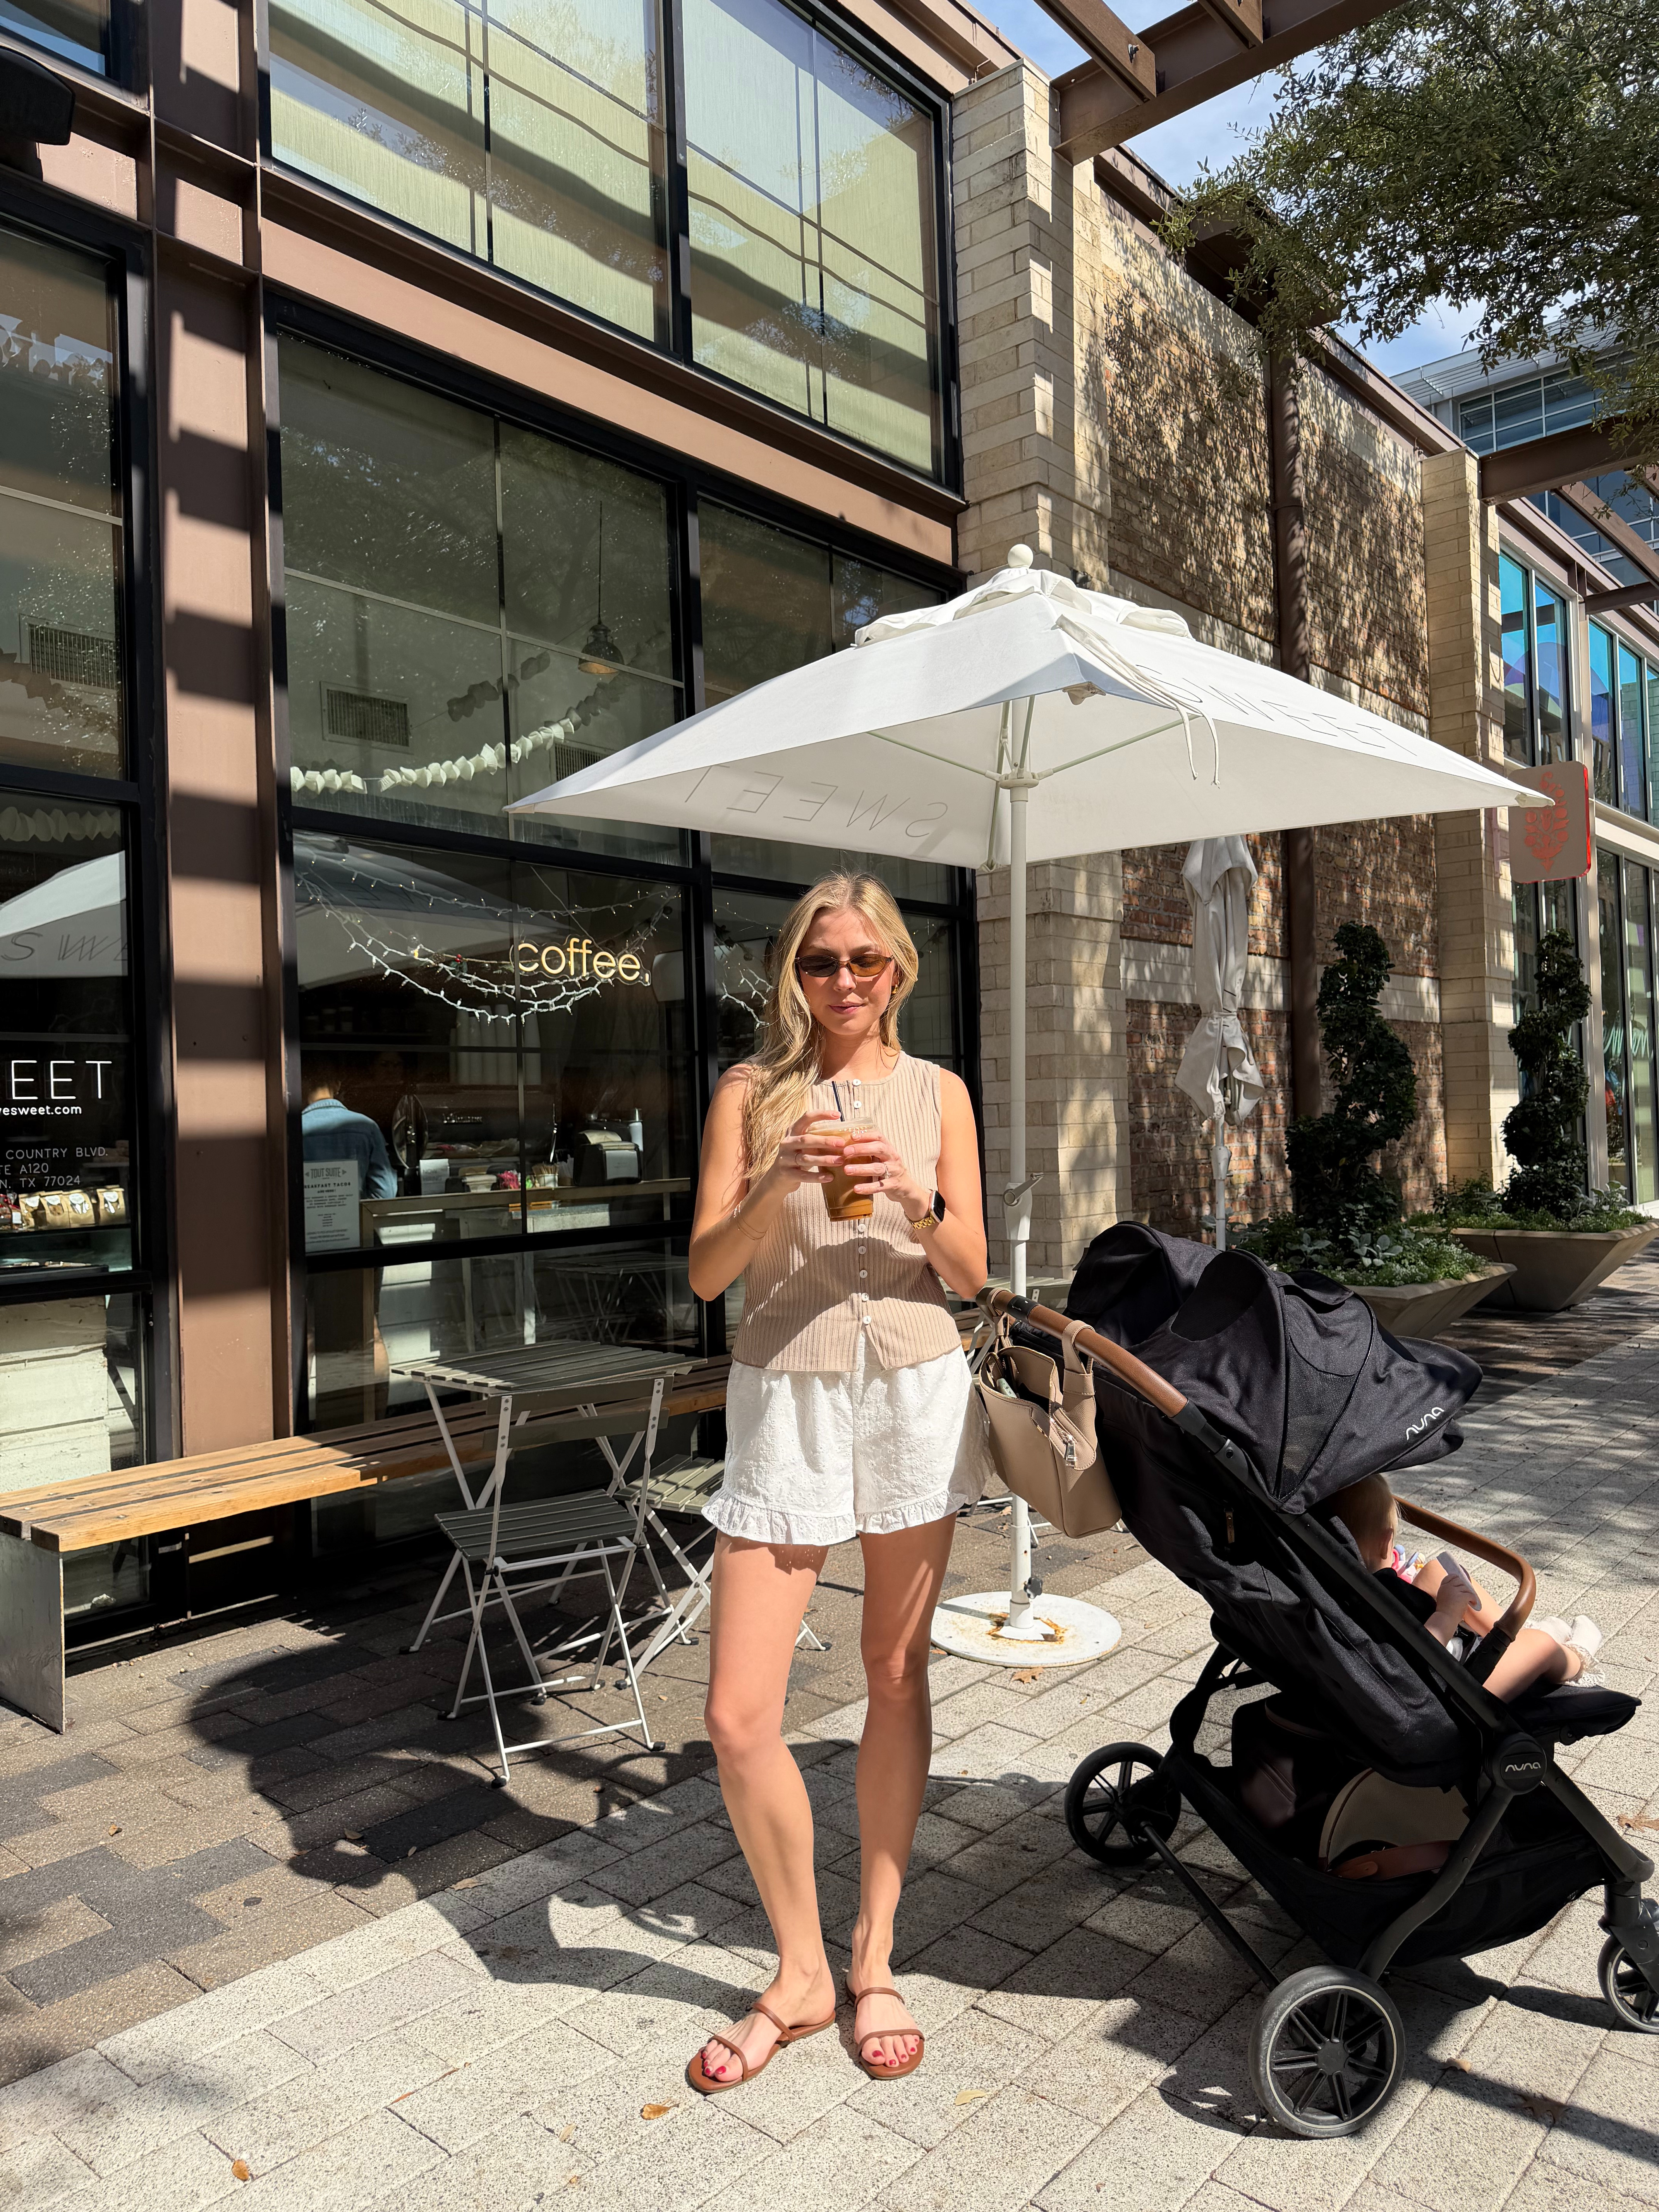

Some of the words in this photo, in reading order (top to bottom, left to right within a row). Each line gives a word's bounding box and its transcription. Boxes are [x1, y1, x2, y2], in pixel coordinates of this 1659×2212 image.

[1135, 665, 1417, 756] SWEET
[6, 1148, 67, 1160] COUNTRY
[76, 1146, 108, 1157] BLVD.
[20, 1163, 49, 1174] A120
[310, 1168, 325, 1179] TOUT
[325, 1167, 341, 1178] SUITE
[19, 1178, 36, 1188] TX
[44, 1175, 81, 1187] 77024
[1406, 1407, 1444, 1440] nuna
[1505, 1762, 1541, 1772] nuna
